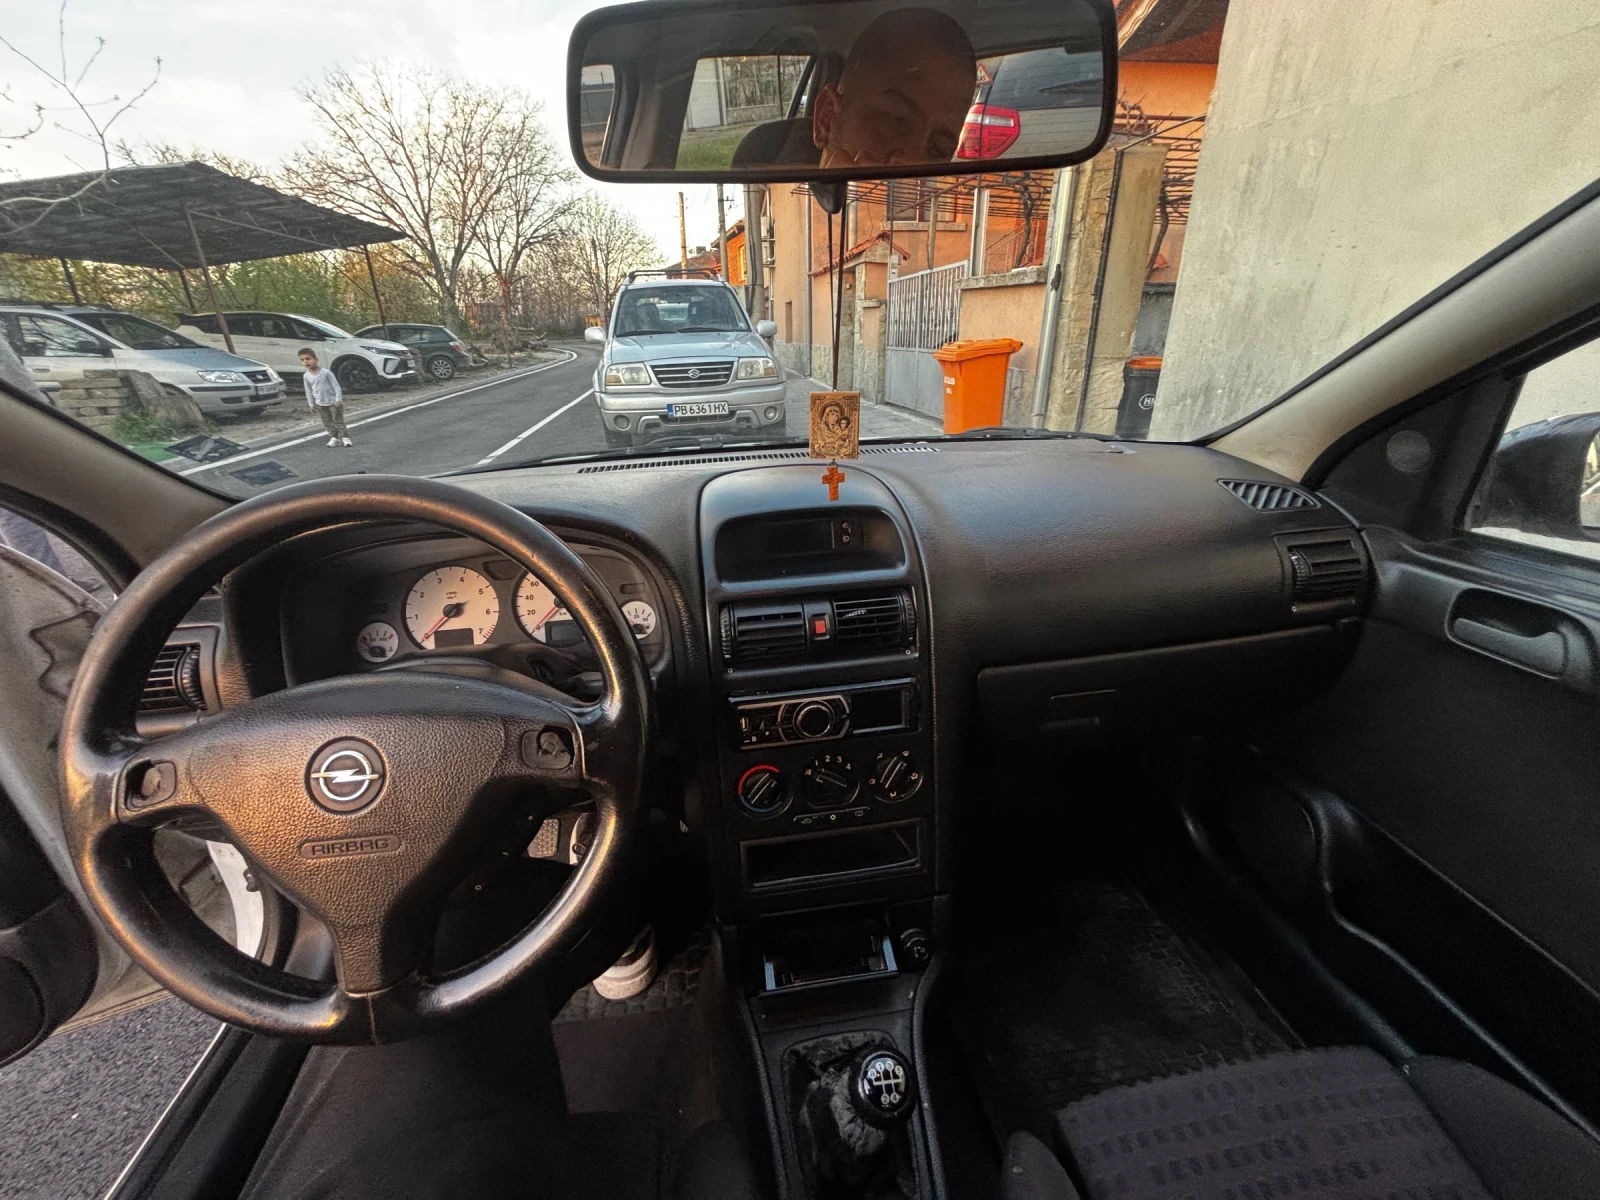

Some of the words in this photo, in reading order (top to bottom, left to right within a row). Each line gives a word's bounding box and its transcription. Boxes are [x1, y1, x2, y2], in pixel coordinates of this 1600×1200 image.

[674, 405, 687, 415] PB
[689, 404, 712, 414] 6361
[714, 403, 727, 413] HX
[825, 754, 830, 762] 2
[311, 838, 389, 856] AIRBAG
